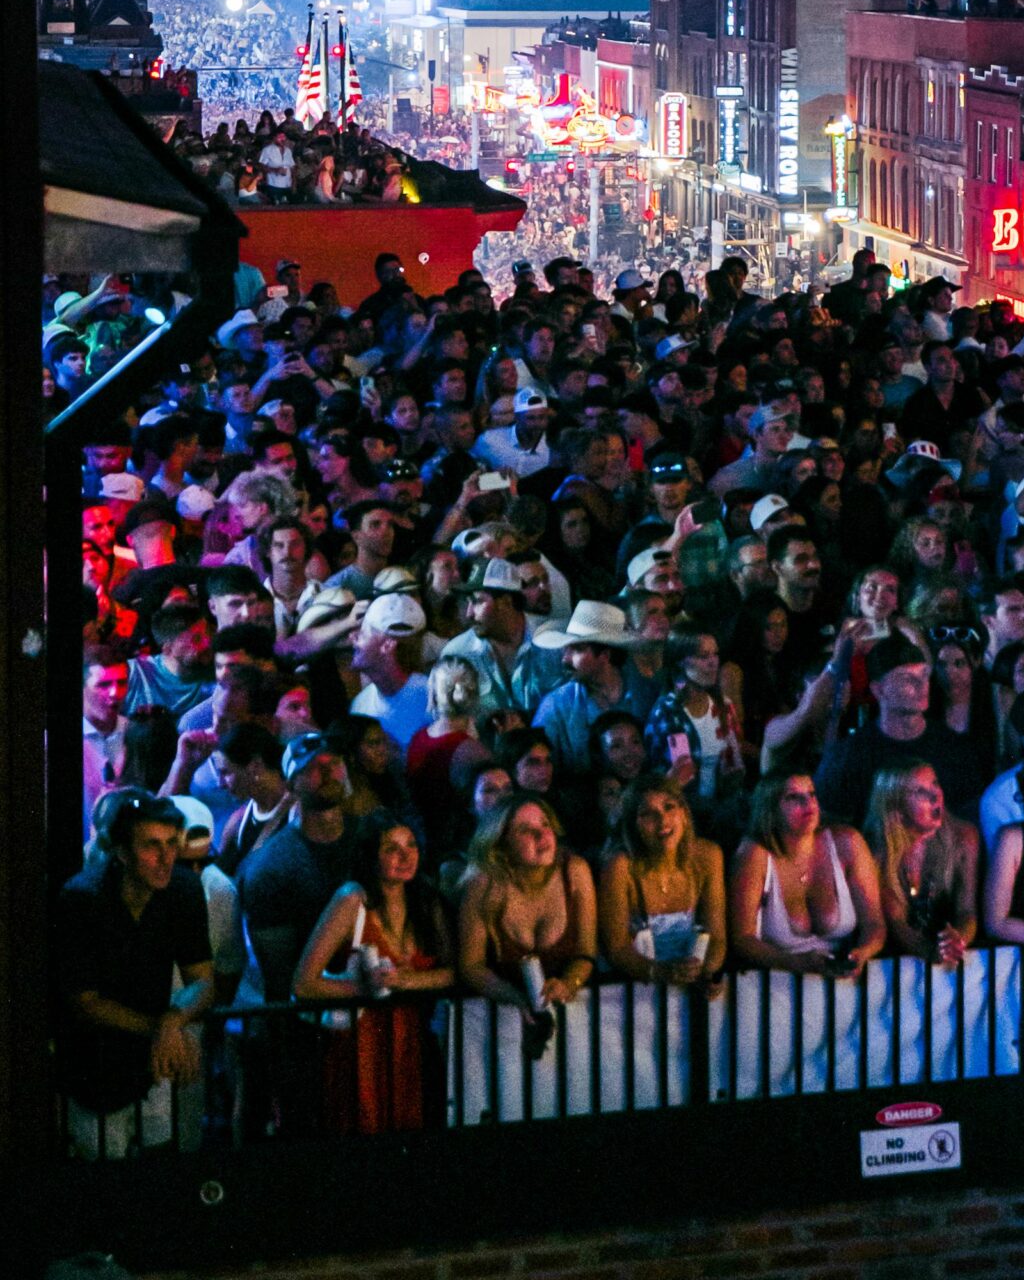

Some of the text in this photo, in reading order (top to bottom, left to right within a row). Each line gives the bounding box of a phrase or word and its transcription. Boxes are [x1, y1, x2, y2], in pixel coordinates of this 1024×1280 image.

[667, 103, 681, 155] SALOON
[779, 48, 798, 195] WHISKEY ROW
[991, 209, 1019, 251] B
[884, 1107, 933, 1122] DANGER
[886, 1137, 904, 1150] NO
[865, 1150, 926, 1168] CLIMBING
